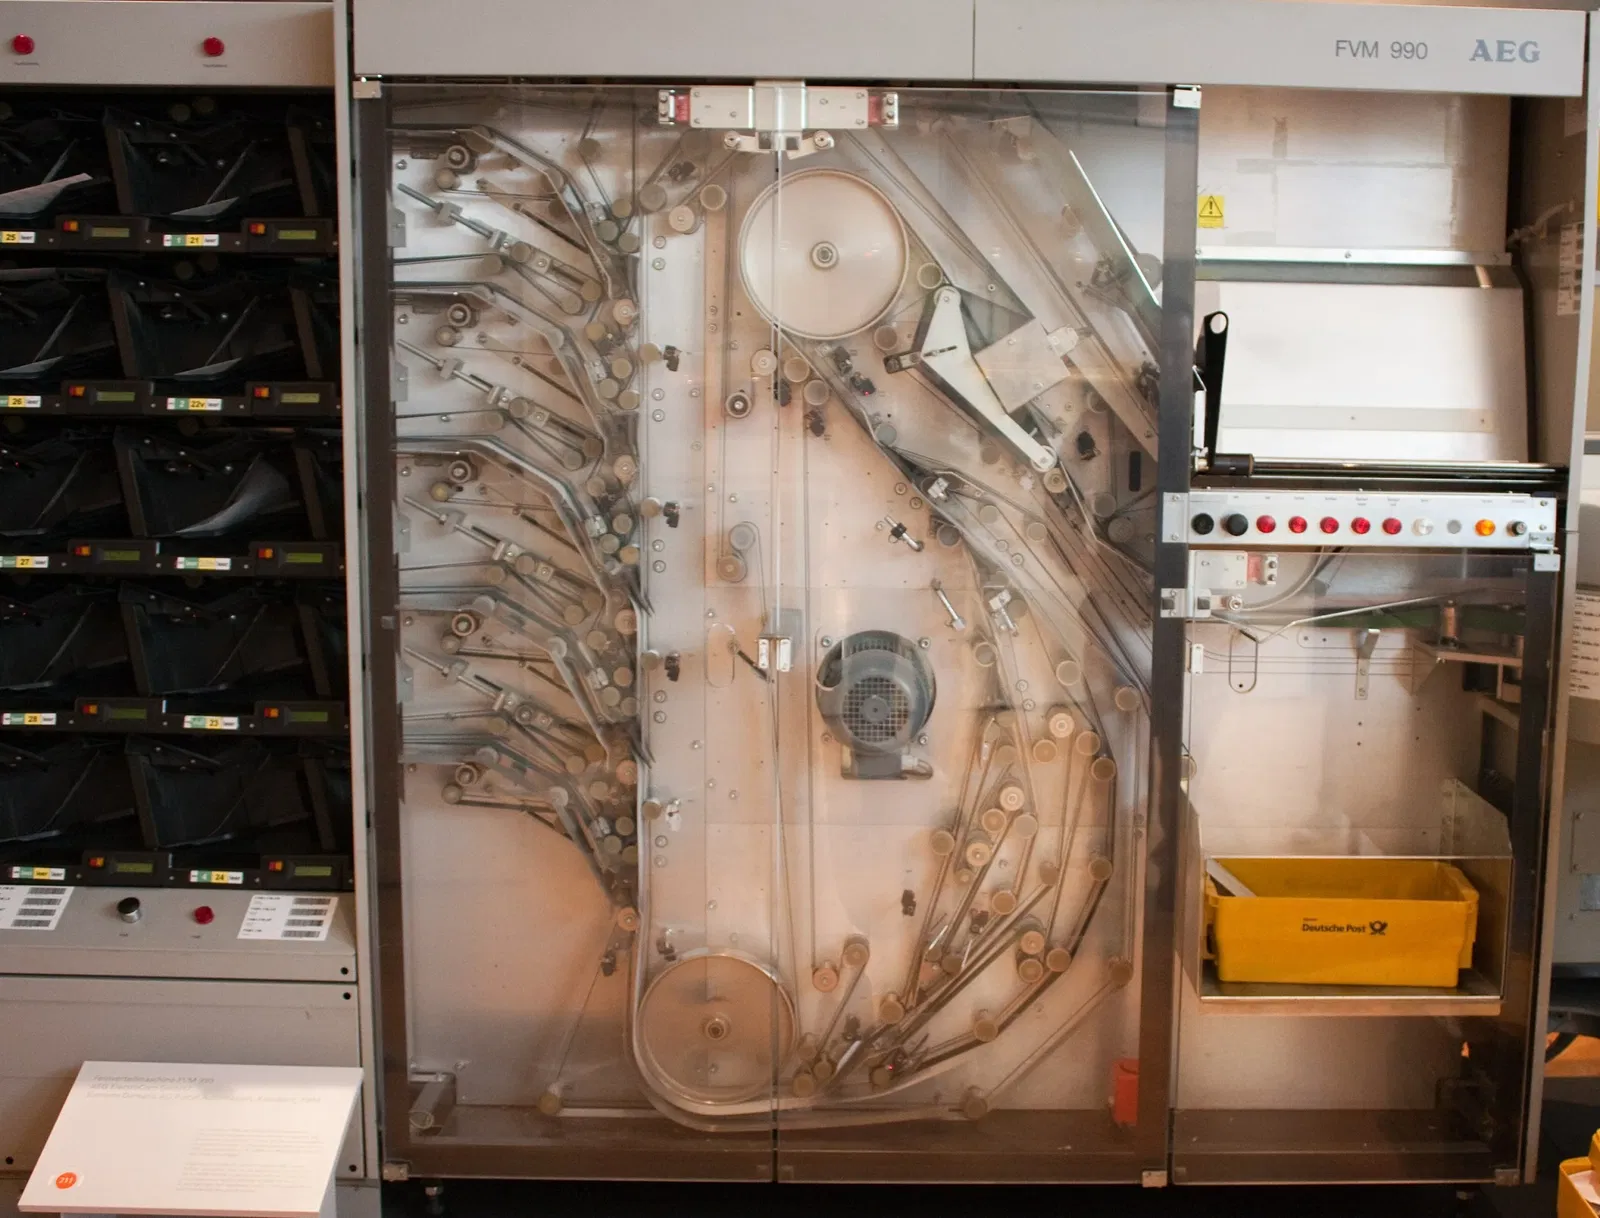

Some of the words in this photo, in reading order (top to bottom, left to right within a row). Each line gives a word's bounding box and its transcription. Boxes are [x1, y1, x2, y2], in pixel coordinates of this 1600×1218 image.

[1335, 40, 1379, 58] FVM
[1390, 41, 1428, 60] 990
[1469, 39, 1540, 63] AEG
[6, 233, 16, 241] 25
[190, 236, 199, 244] 21
[12, 397, 22, 405] 26
[180, 400, 185, 408] 2
[20, 558, 30, 566] 27
[28, 715, 38, 723] 28
[215, 873, 225, 881] 24
[1302, 923, 1345, 933] Deutsche
[1346, 924, 1366, 934] Post
